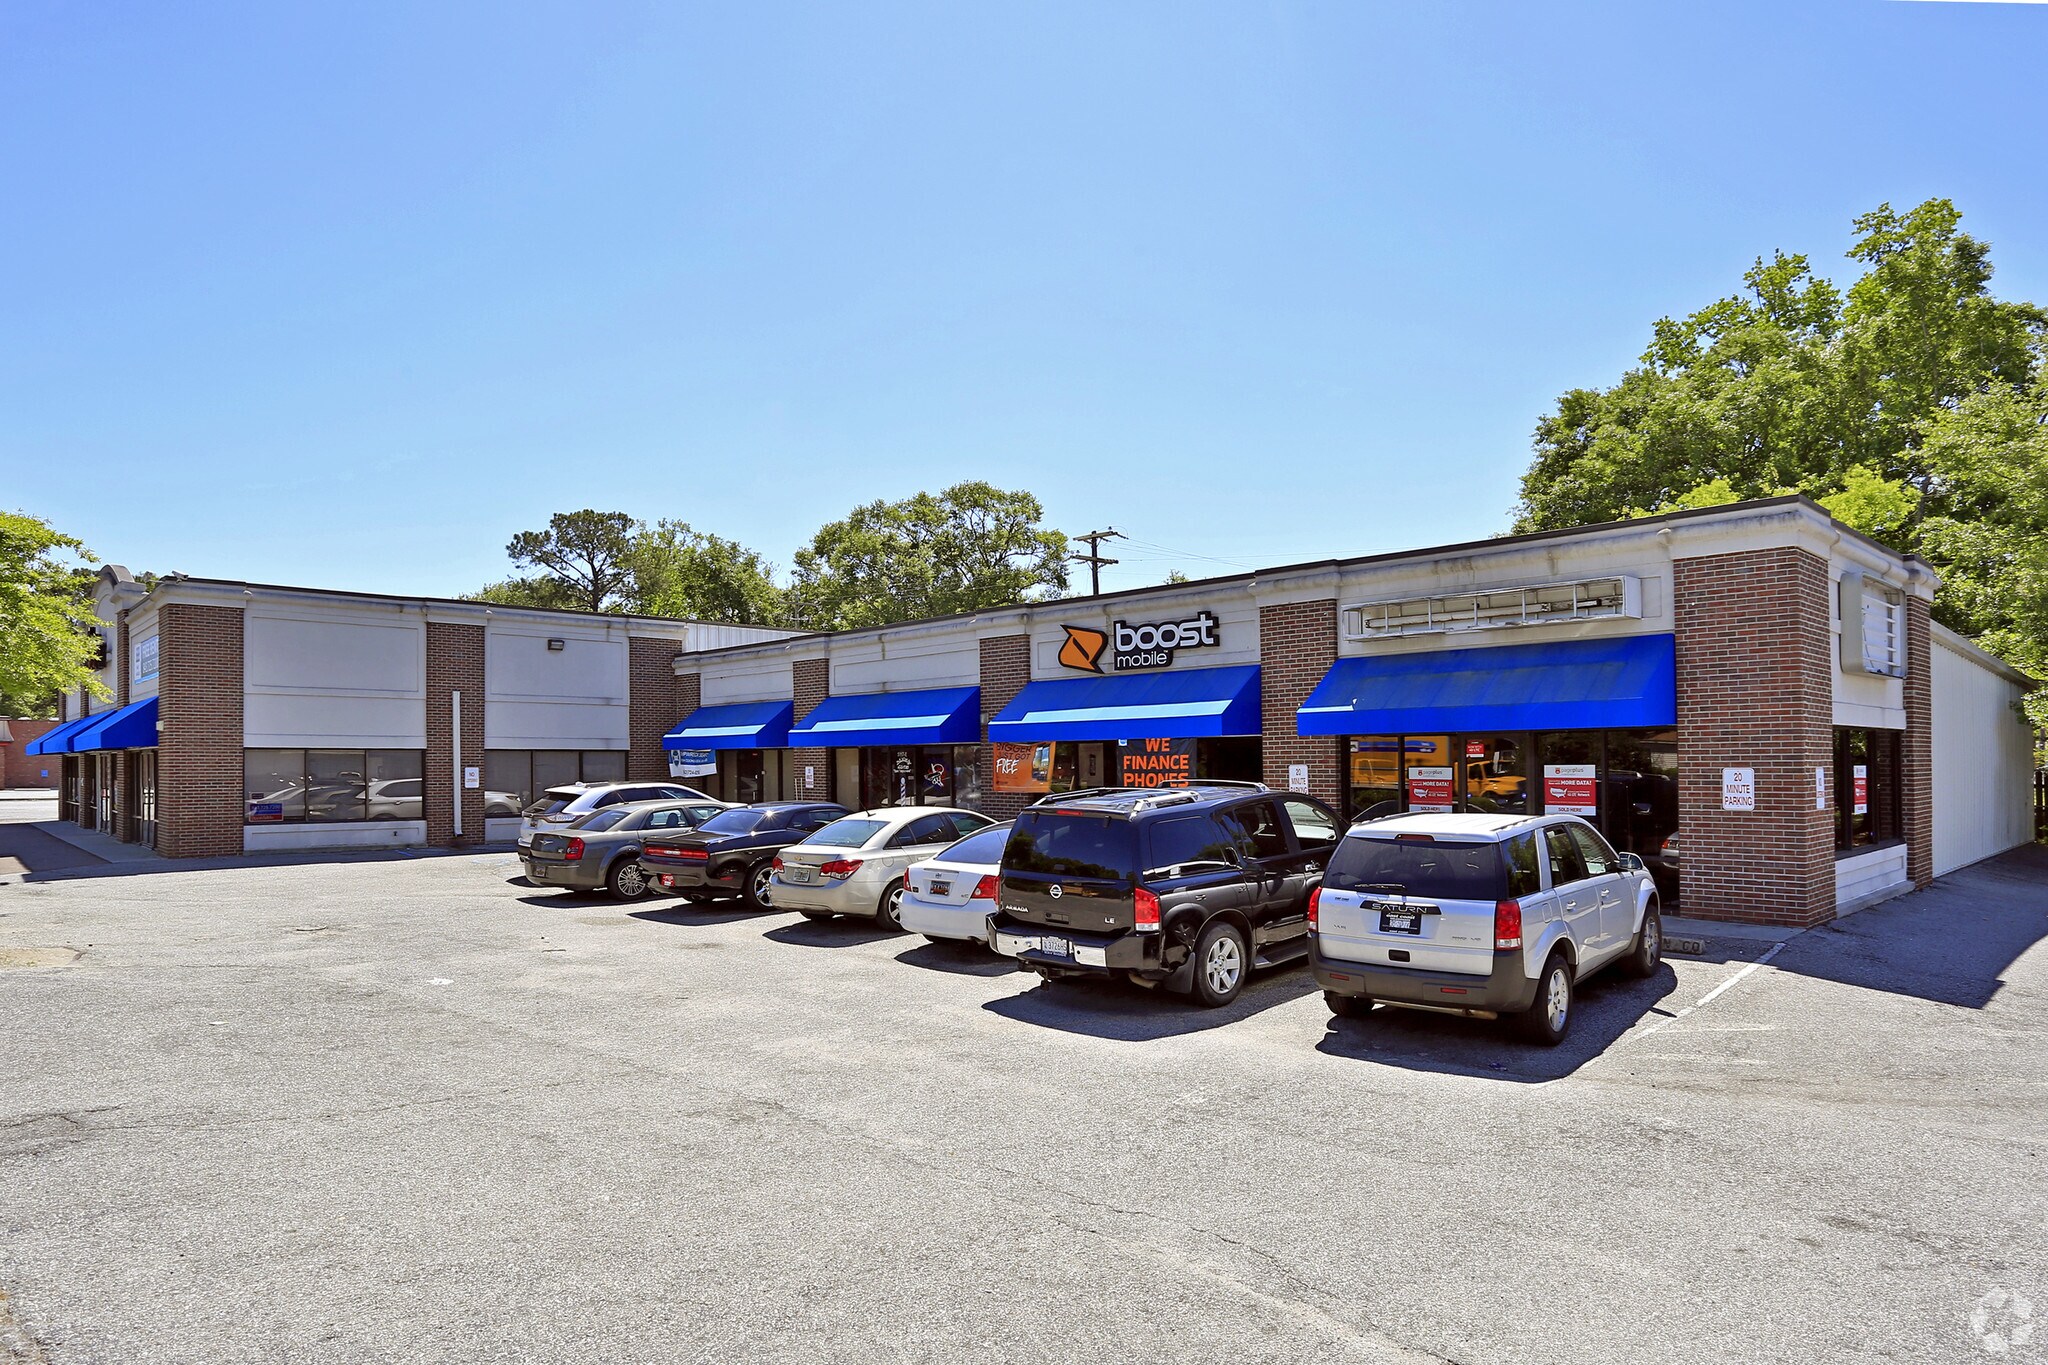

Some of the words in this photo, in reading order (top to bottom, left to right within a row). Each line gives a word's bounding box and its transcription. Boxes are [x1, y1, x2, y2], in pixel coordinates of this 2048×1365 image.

[1115, 613, 1214, 652] boost
[1117, 651, 1168, 668] mobile
[997, 742, 1032, 753] BIGGER
[1145, 737, 1171, 753] WE
[1014, 753, 1030, 761] GOT
[1123, 754, 1190, 770] FINANCE
[996, 758, 1019, 775] FREE
[1123, 772, 1190, 788] PHONES
[1733, 772, 1743, 782] 20
[1726, 784, 1751, 794] MINUTE
[1724, 796, 1753, 806] PARKING
[1005, 904, 1029, 913] ARMADA
[1371, 903, 1428, 914] SATURN
[1104, 916, 1115, 924] LE
